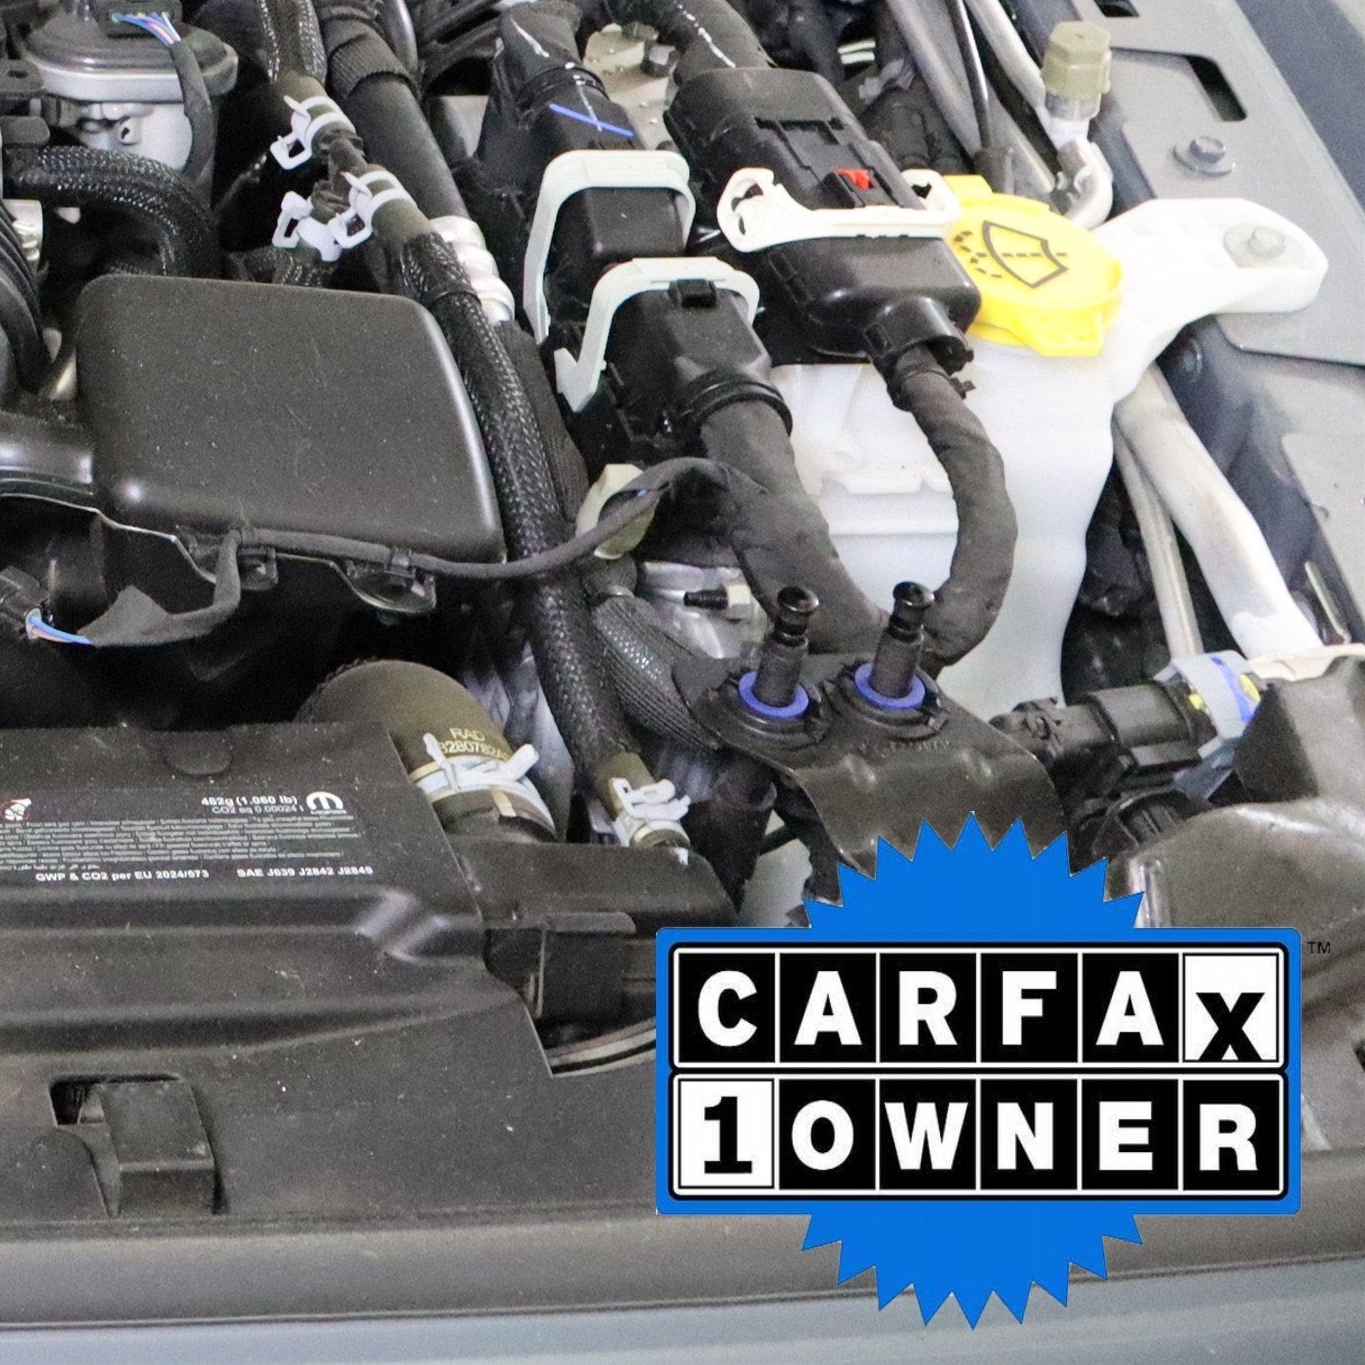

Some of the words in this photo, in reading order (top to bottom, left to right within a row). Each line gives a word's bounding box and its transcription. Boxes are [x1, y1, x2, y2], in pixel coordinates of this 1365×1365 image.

[449, 727, 486, 742] RAD
[211, 806, 237, 815] CO2
[35, 872, 66, 882] GWP
[69, 872, 79, 881] &
[81, 871, 109, 881] CO2
[111, 872, 132, 882] per
[134, 870, 153, 880] EU
[236, 868, 265, 878] SAE
